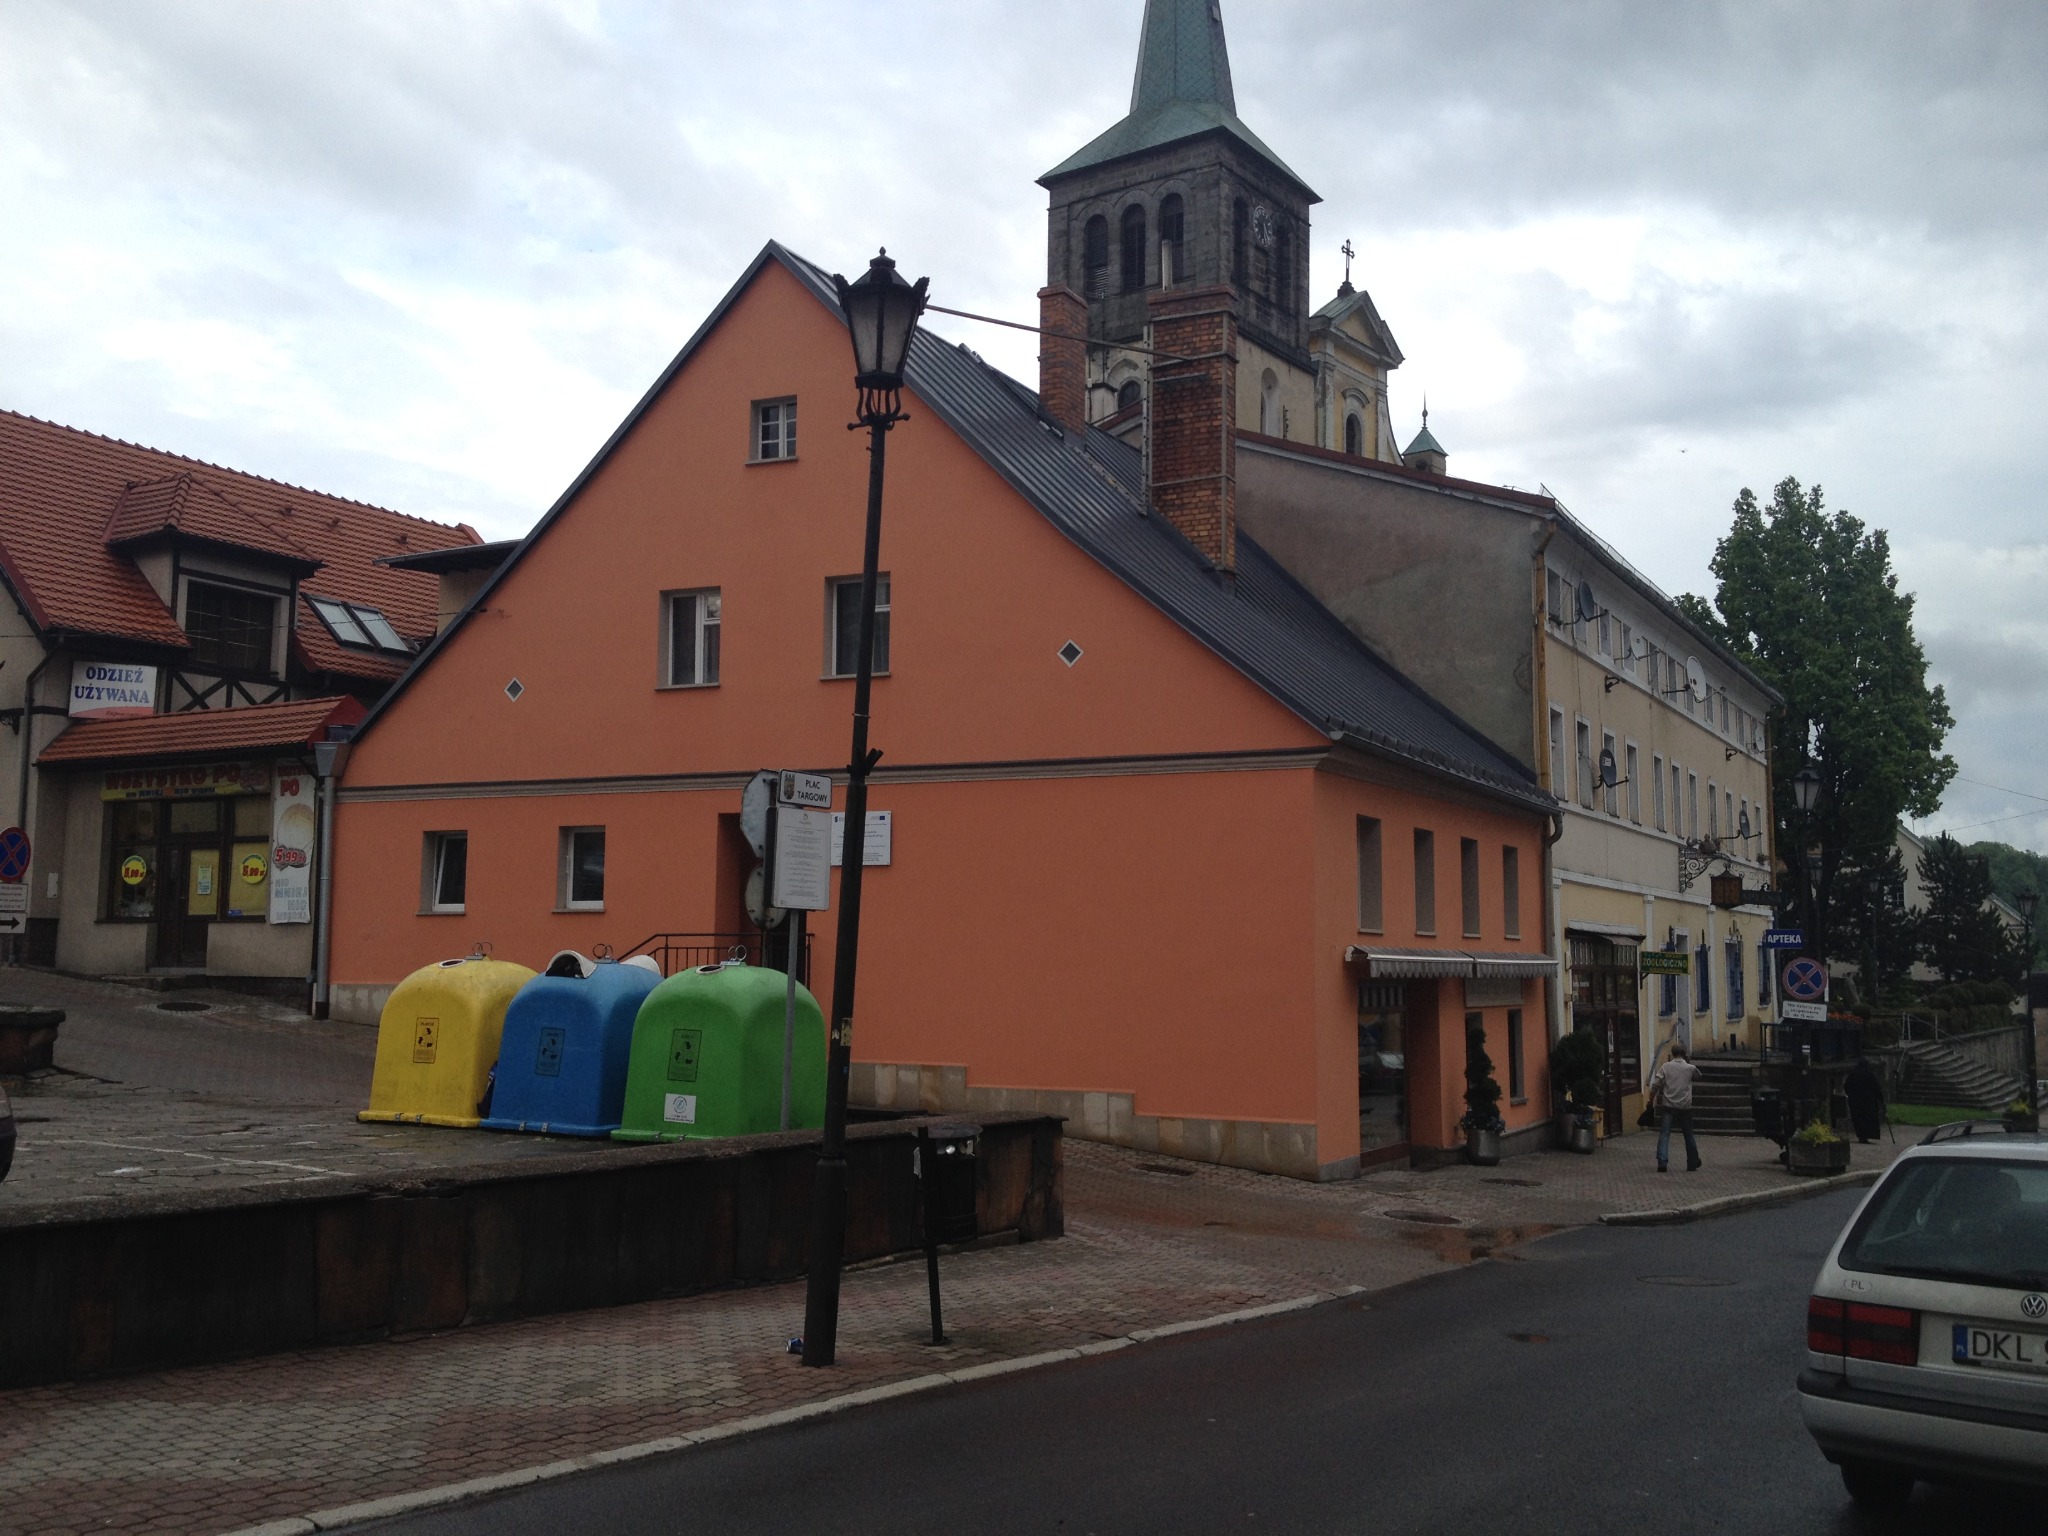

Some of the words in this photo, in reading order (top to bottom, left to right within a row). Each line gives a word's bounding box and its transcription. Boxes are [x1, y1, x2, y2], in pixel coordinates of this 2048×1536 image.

[280, 779, 300, 796] PO
[805, 779, 820, 789] PLAC
[797, 791, 828, 802] TARGOWY
[1767, 934, 1802, 943] APTEKA
[1850, 1280, 1865, 1289] PL
[1972, 1330, 2033, 1362] DKL
